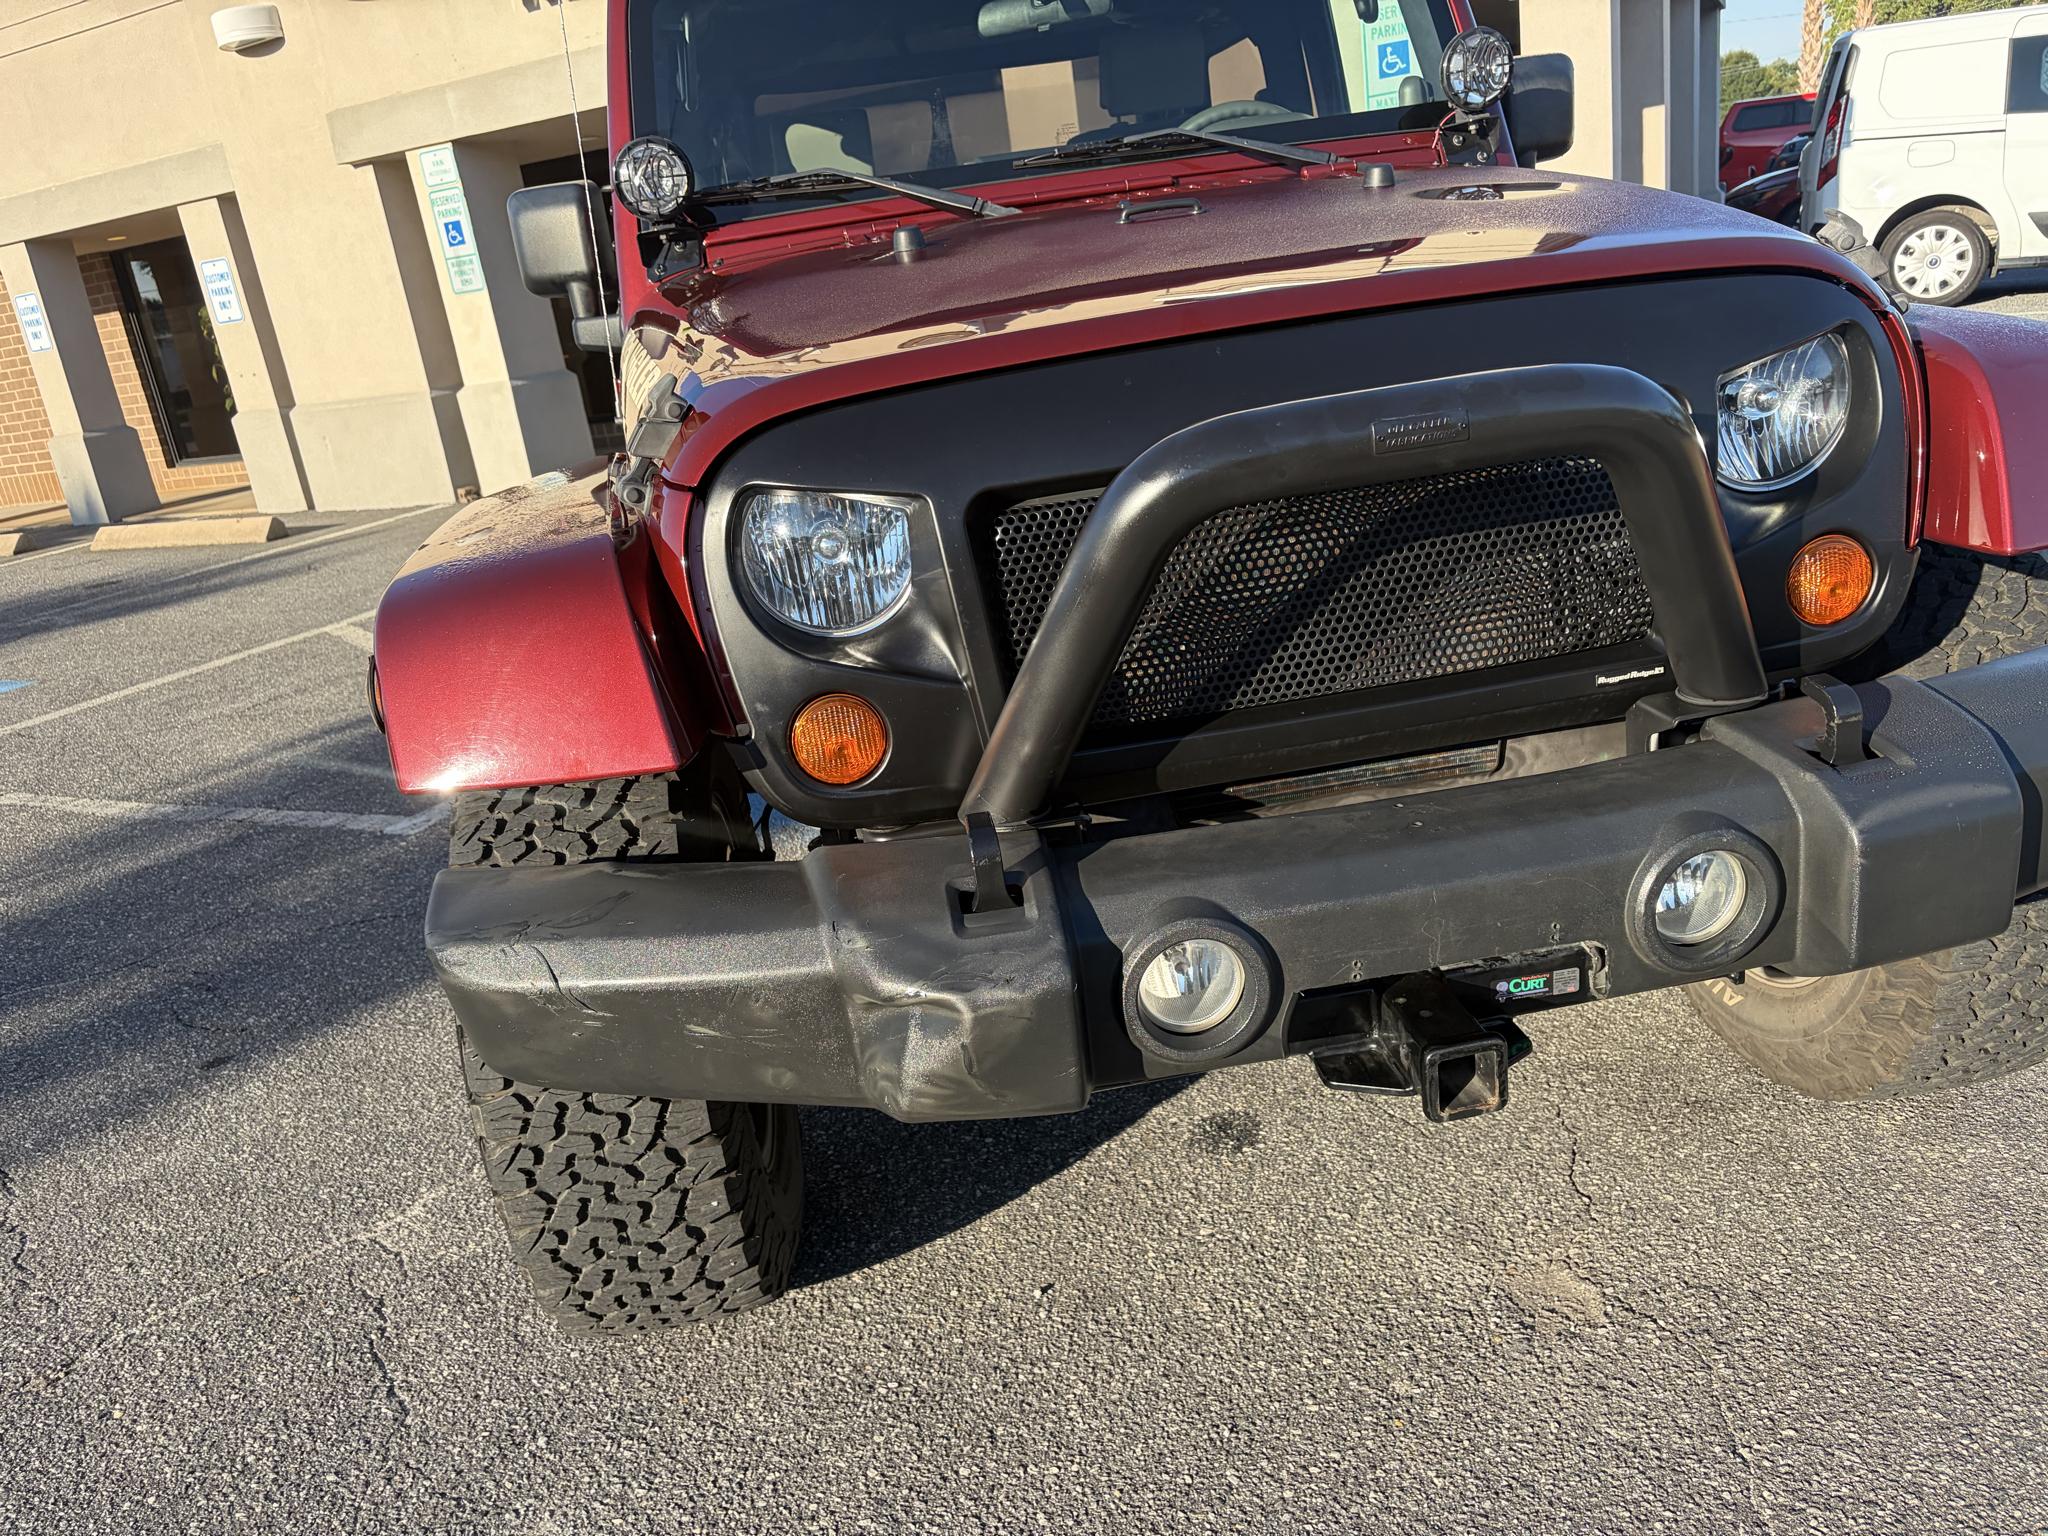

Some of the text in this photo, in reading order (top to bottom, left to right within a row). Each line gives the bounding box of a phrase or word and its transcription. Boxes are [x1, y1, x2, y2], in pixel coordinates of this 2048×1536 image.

[1371, 23, 1407, 40] PARKIN
[1376, 97, 1398, 108] MAXI
[431, 194, 461, 207] RESERVED
[437, 207, 462, 219] PARKING
[206, 272, 230, 285] CUSTOMER
[211, 285, 233, 298] PARKING
[19, 305, 39, 317] CUSTOMER
[219, 300, 232, 311] ONLY
[24, 318, 42, 329] PARKING
[31, 331, 42, 340] ONLY
[1508, 978, 1547, 993] CURT
